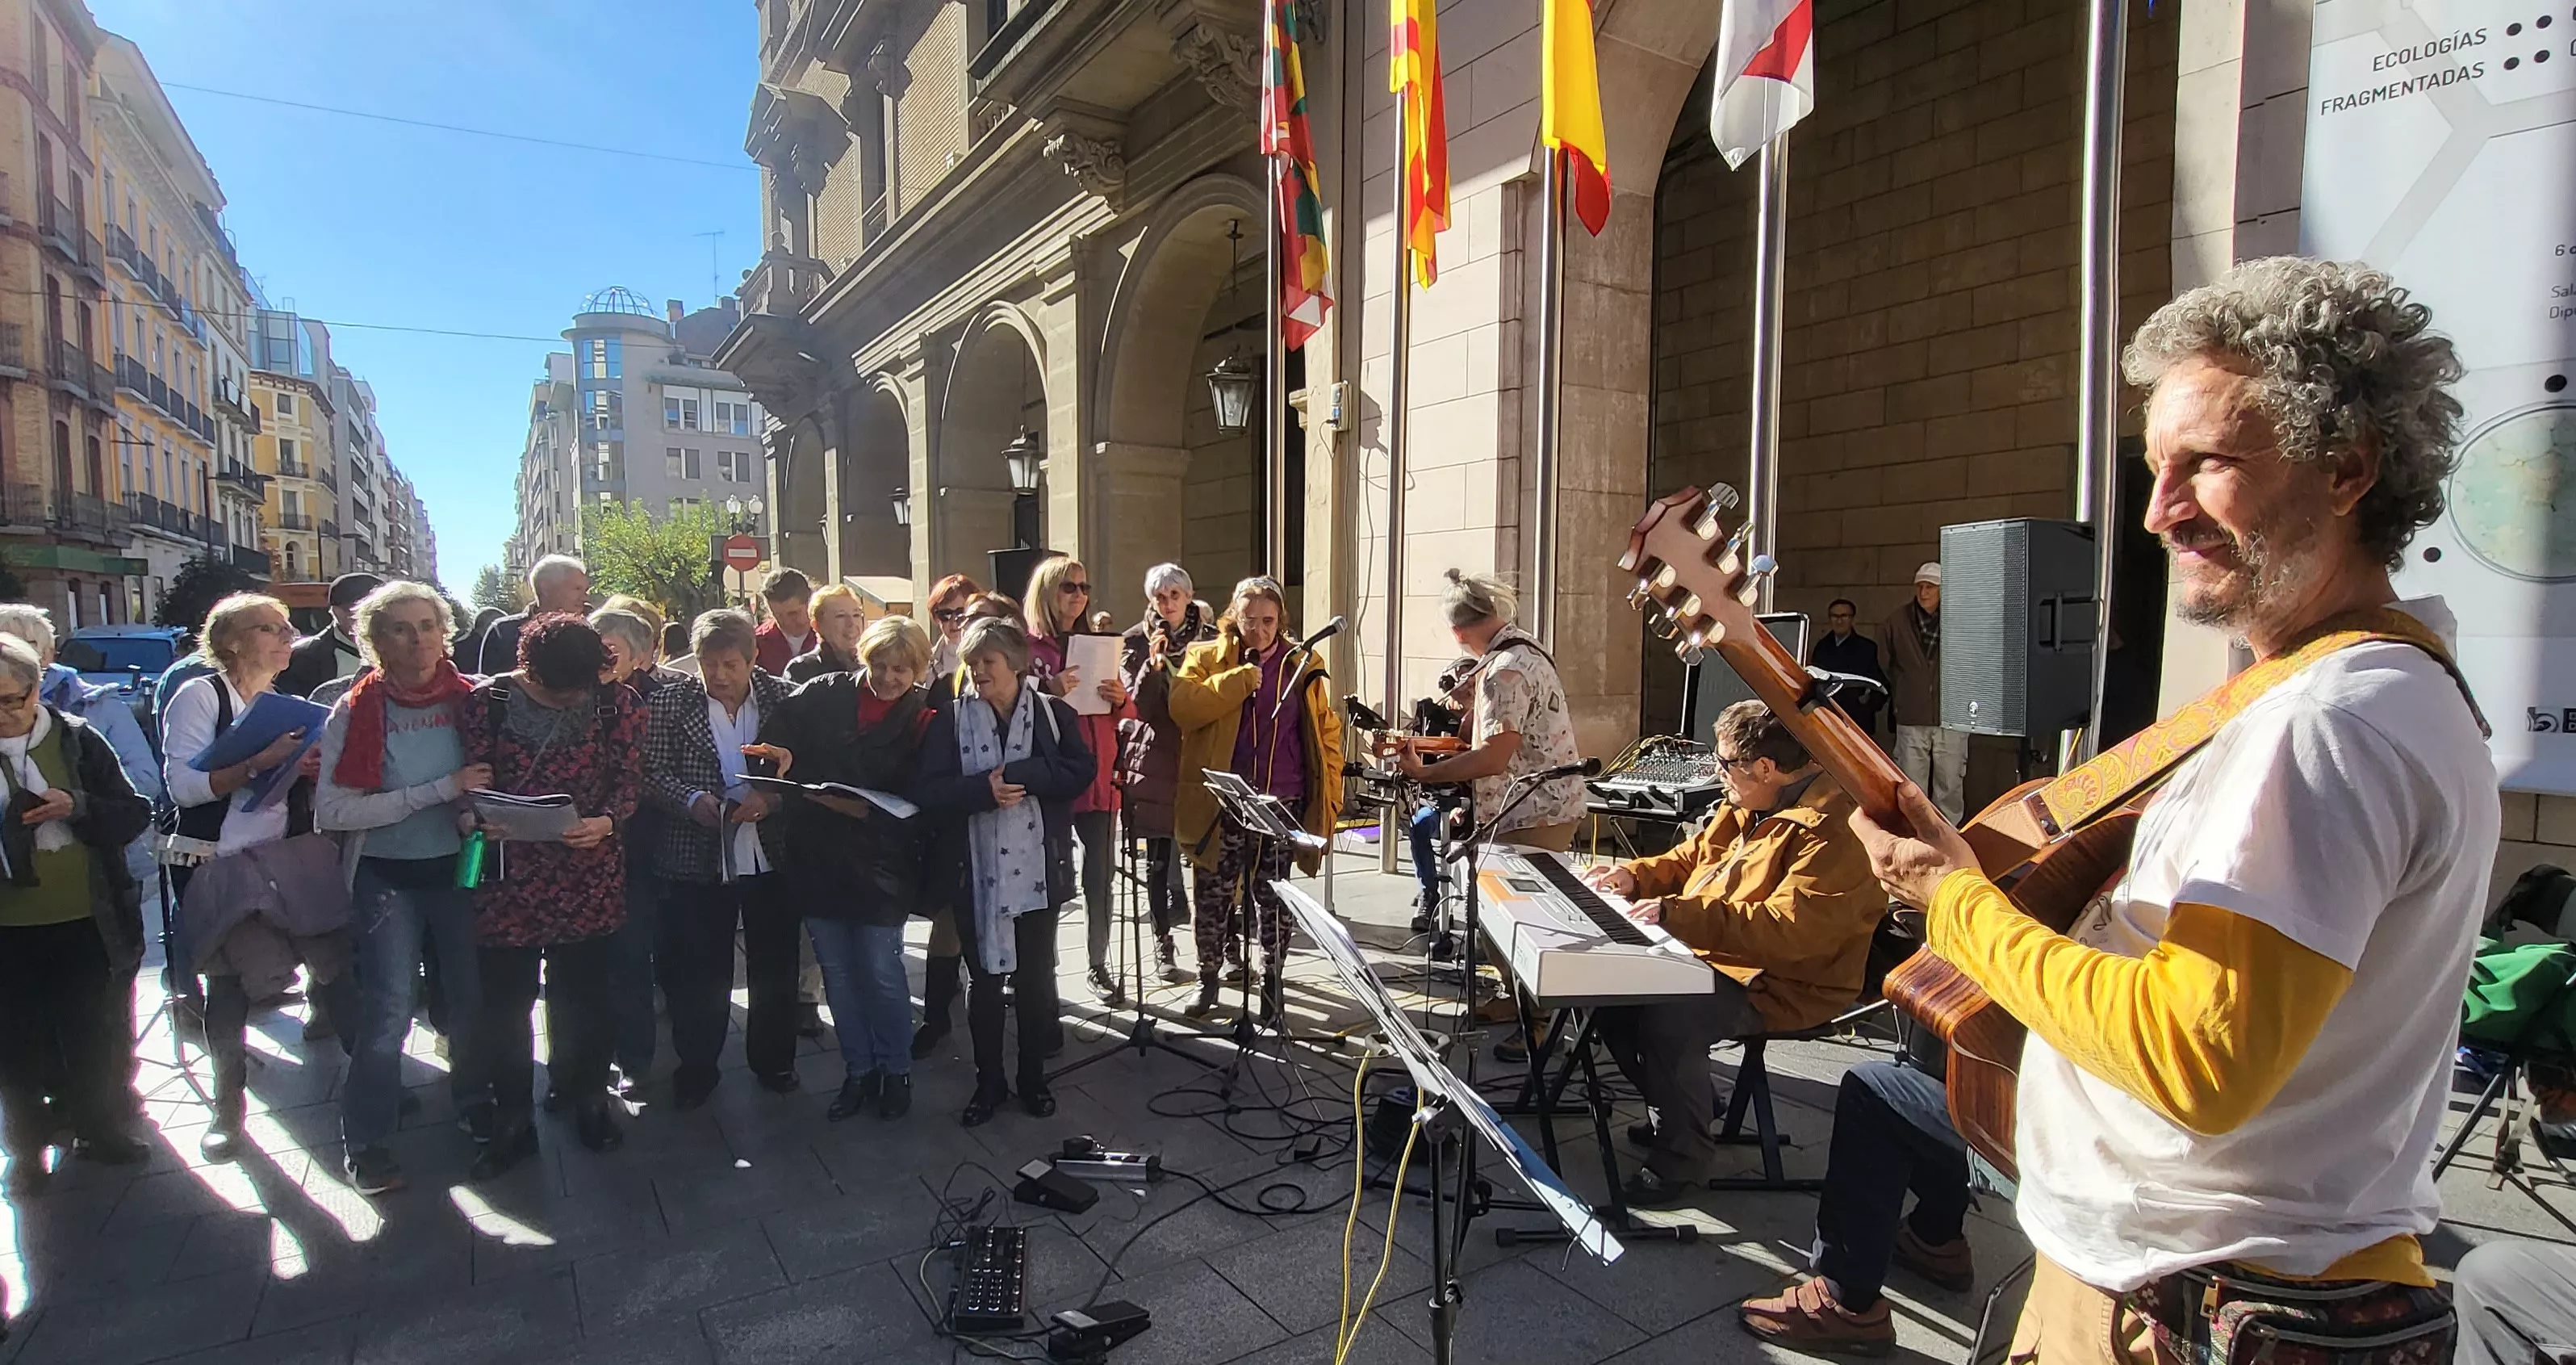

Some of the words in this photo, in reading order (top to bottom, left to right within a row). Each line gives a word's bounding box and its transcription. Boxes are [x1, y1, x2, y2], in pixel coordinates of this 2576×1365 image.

[2373, 27, 2487, 72] ECOLOGÍAS
[2320, 61, 2486, 116] FRAGMENTADAS
[2554, 244, 2566, 257] 6
[2549, 306, 2576, 320] Dip
